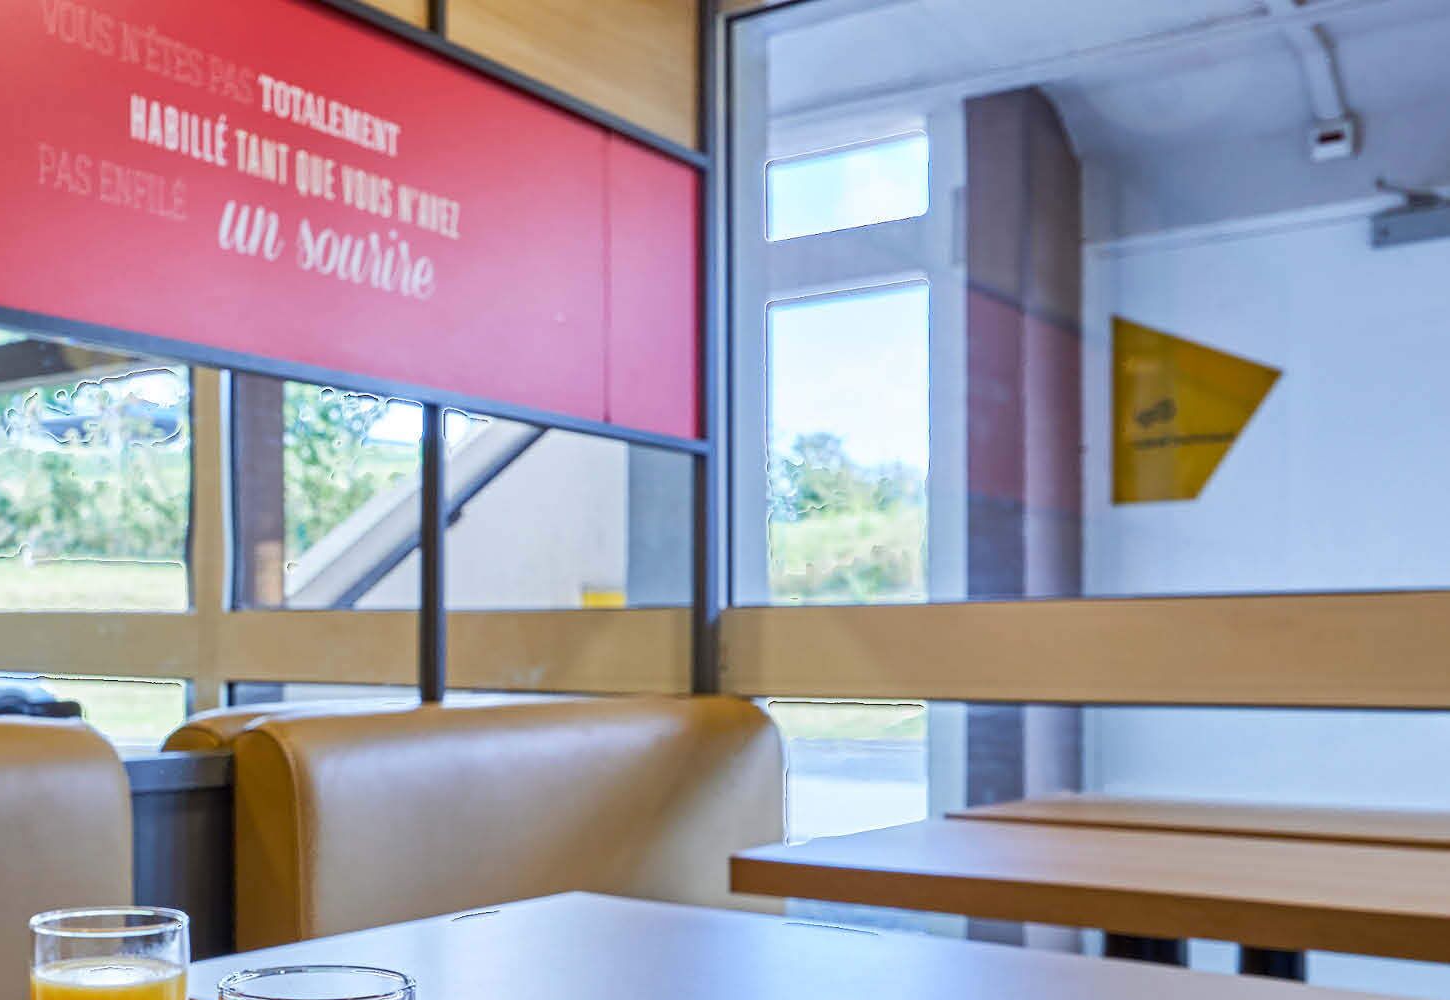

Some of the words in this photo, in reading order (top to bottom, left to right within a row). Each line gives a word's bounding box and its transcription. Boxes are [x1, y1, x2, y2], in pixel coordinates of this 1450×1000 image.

[40, 0, 114, 56] VOUS
[207, 53, 254, 104] PAS
[258, 74, 401, 157] TOTALEMENT
[38, 142, 92, 195] PAS
[100, 159, 188, 221] ENFILÉ
[218, 200, 285, 261] un
[297, 218, 436, 300] sourire
[130, 94, 229, 167] HABILLÉ
[235, 129, 289, 185] TANT
[296, 150, 336, 201] QUE
[342, 165, 393, 218] VOUS
[398, 184, 461, 240] N'AVEZ
